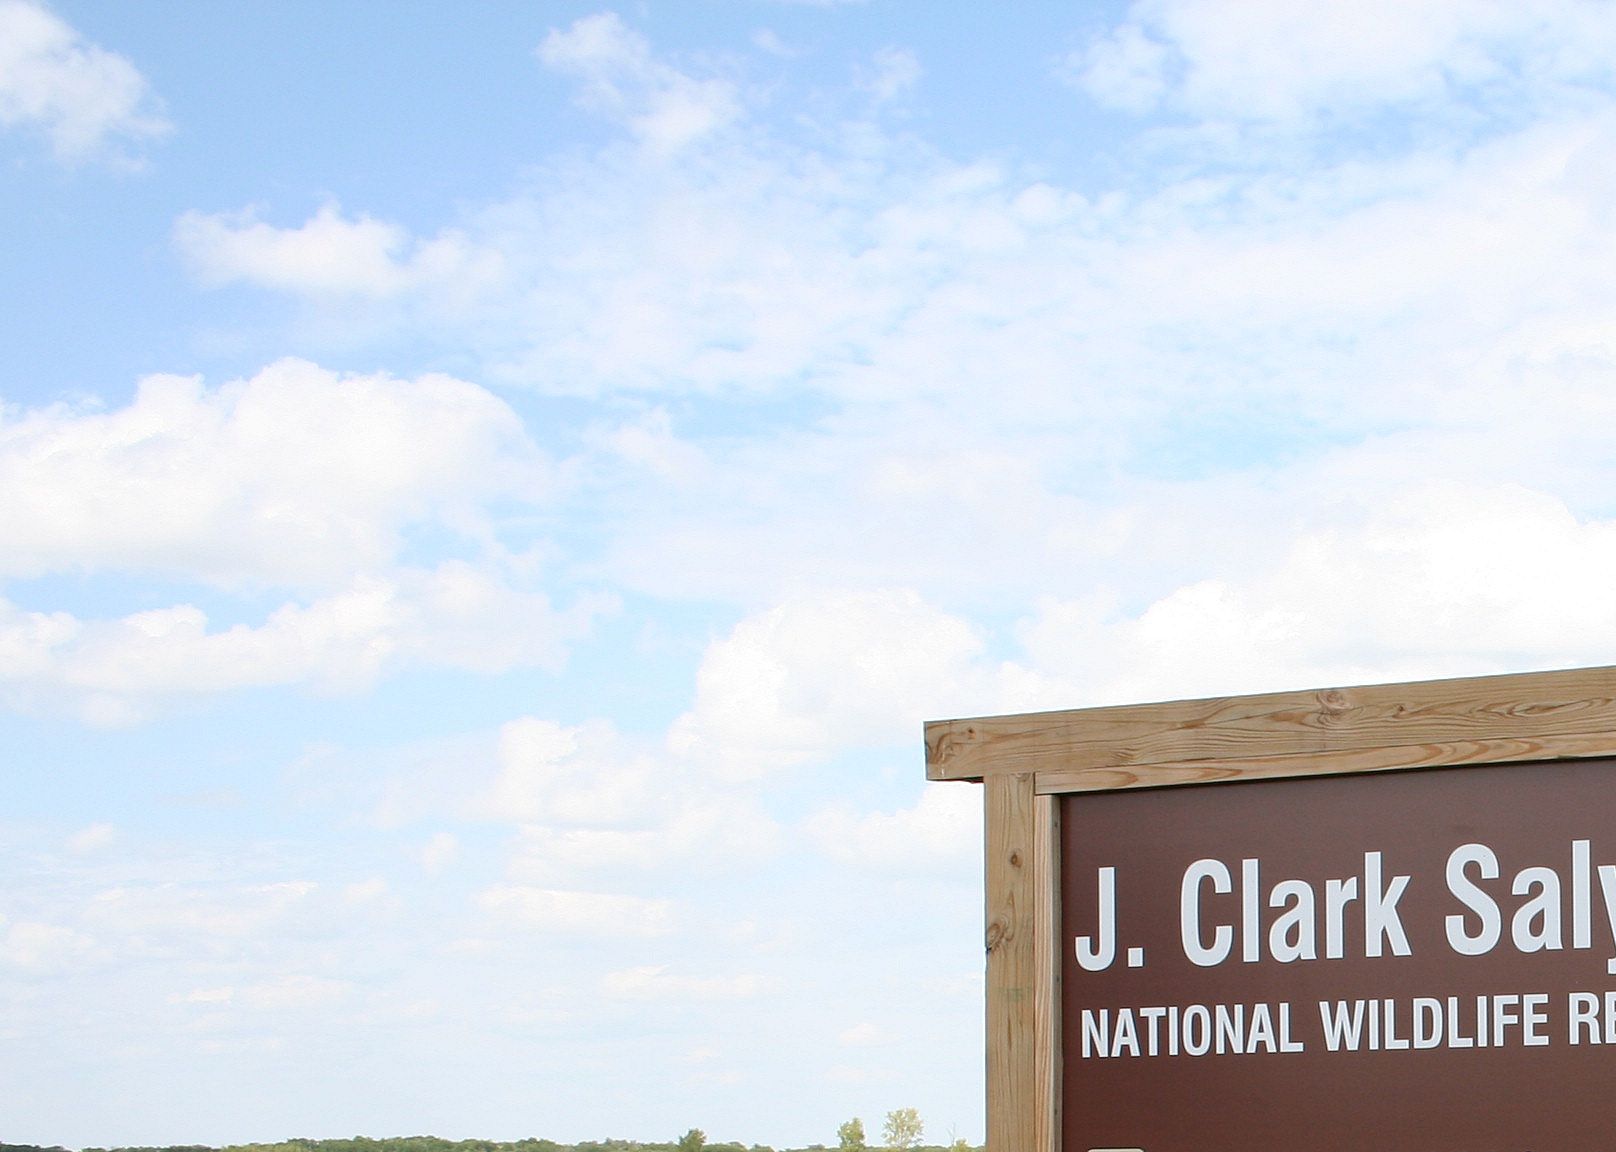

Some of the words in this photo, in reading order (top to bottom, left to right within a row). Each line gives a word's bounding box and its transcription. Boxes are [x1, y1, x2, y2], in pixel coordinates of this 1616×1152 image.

[1075, 866, 1144, 972] J.
[1180, 850, 1413, 967] Clark
[1081, 1002, 1304, 1058] NATIONAL
[1318, 993, 1550, 1052] WILDLIFE
